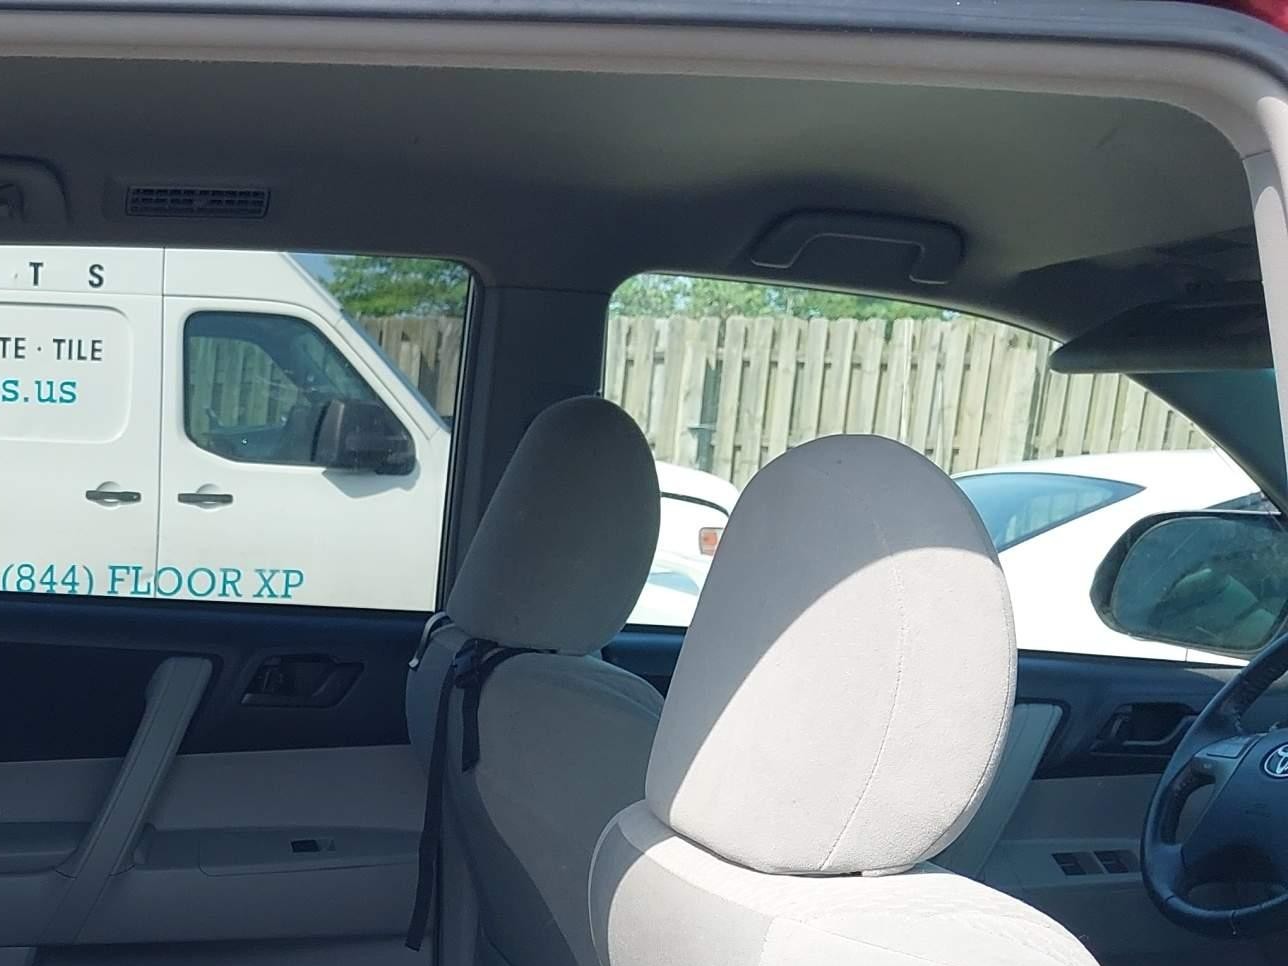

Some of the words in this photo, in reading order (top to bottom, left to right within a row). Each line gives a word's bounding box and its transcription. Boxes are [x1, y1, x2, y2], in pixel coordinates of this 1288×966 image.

[53, 337, 103, 361] TILE
[2, 563, 94, 595] (844)
[107, 565, 242, 598] FLOOR
[253, 568, 305, 598] XP
